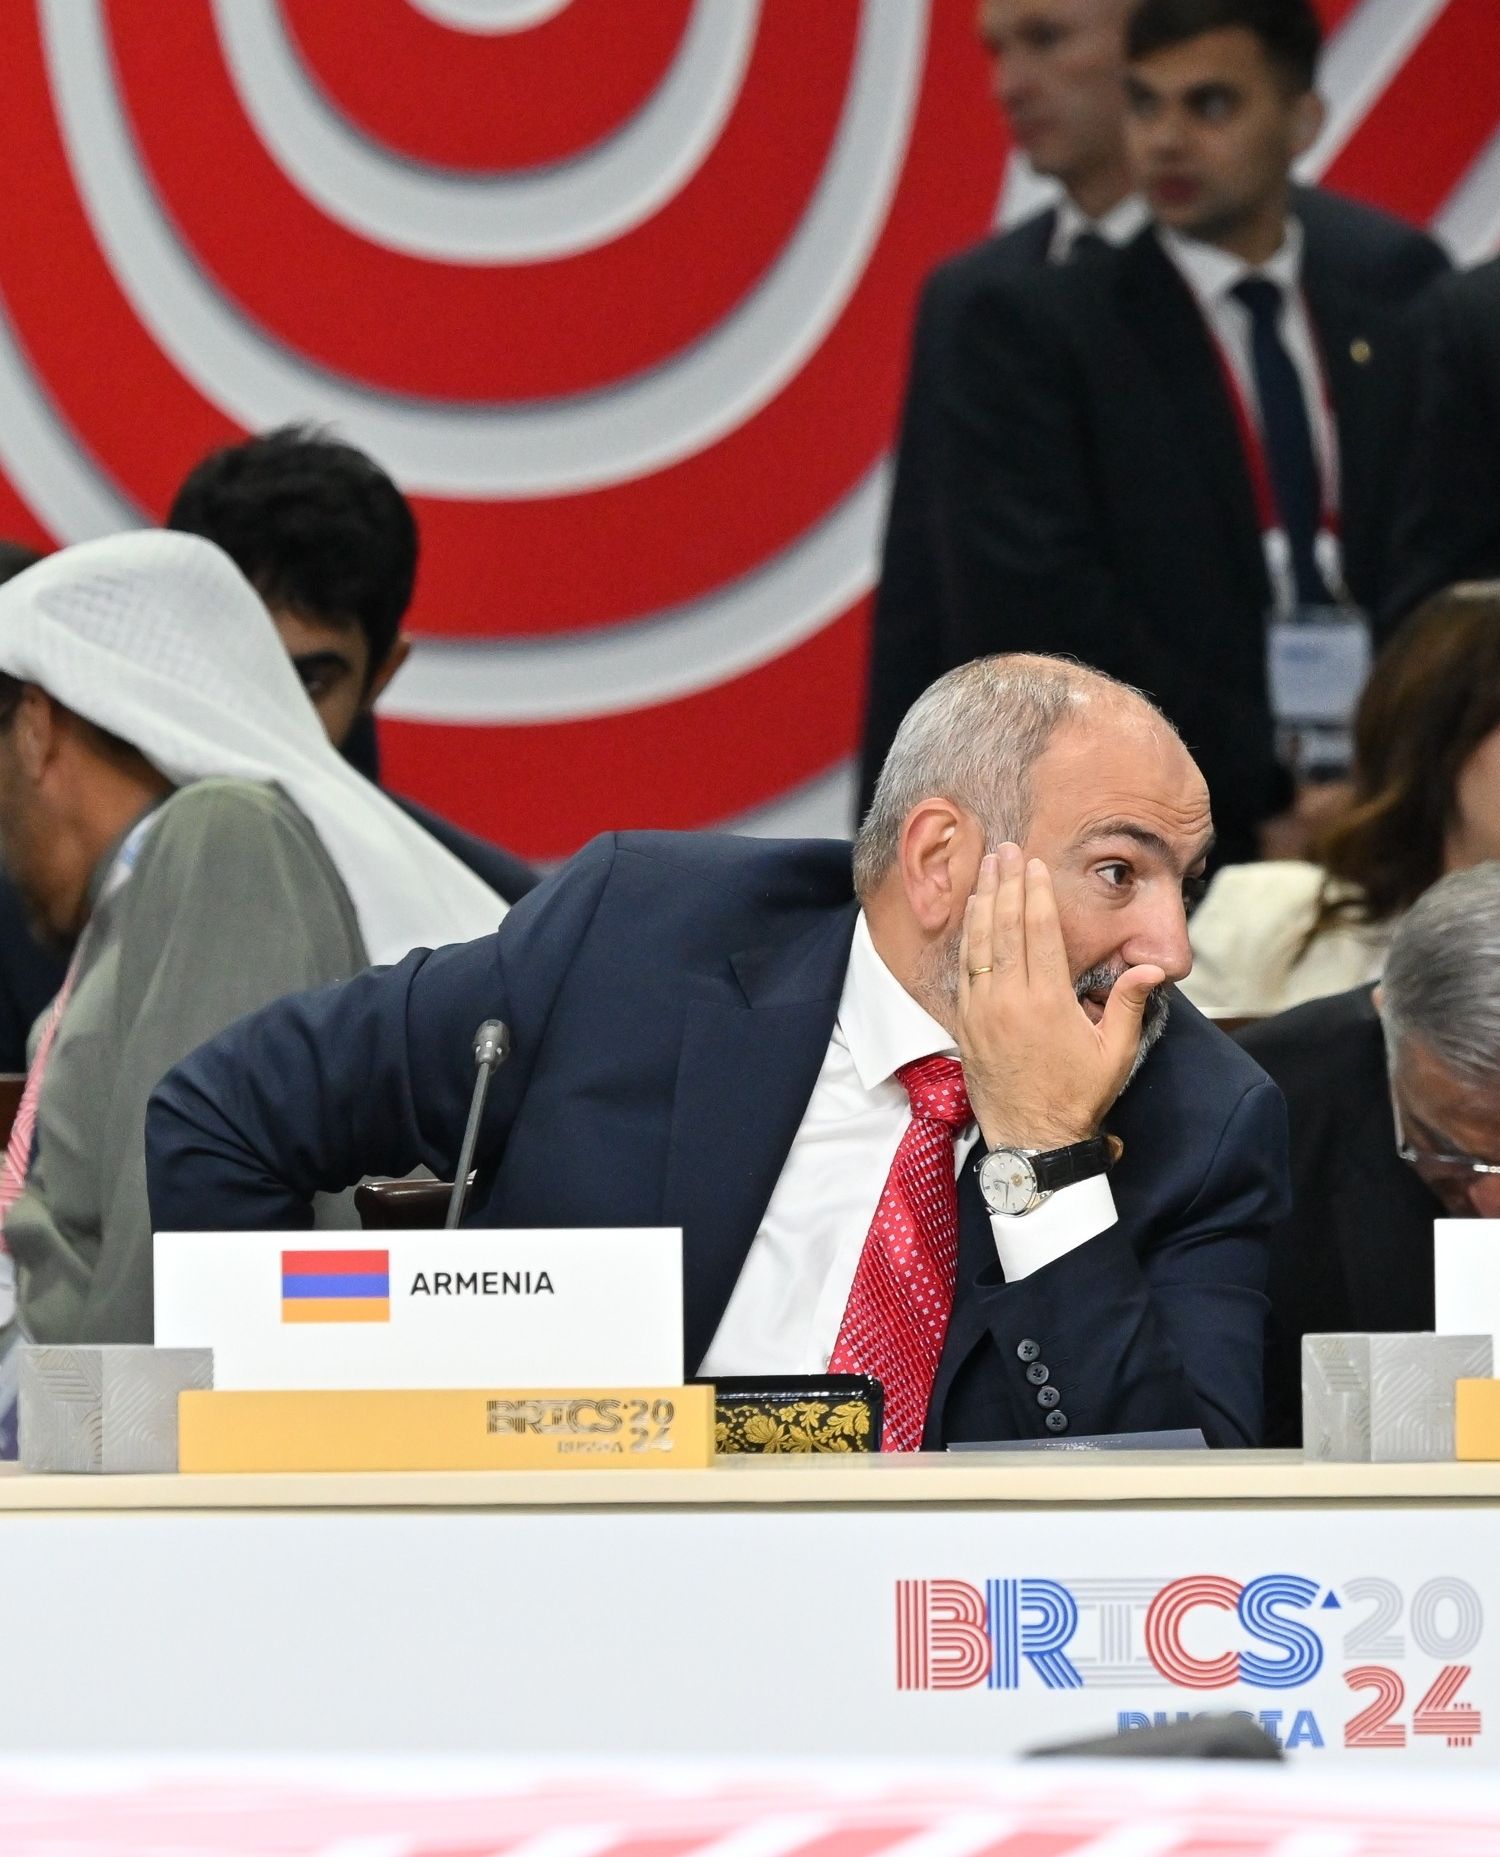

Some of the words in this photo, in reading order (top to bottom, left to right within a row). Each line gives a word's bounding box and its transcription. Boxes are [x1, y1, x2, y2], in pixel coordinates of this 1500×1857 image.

[410, 1270, 555, 1296] ARMENIA
[486, 1398, 623, 1434] BRICS
[896, 1574, 1324, 1690] BRICS
[1342, 1576, 1484, 1660] 20
[1342, 1665, 1482, 1748] 24
